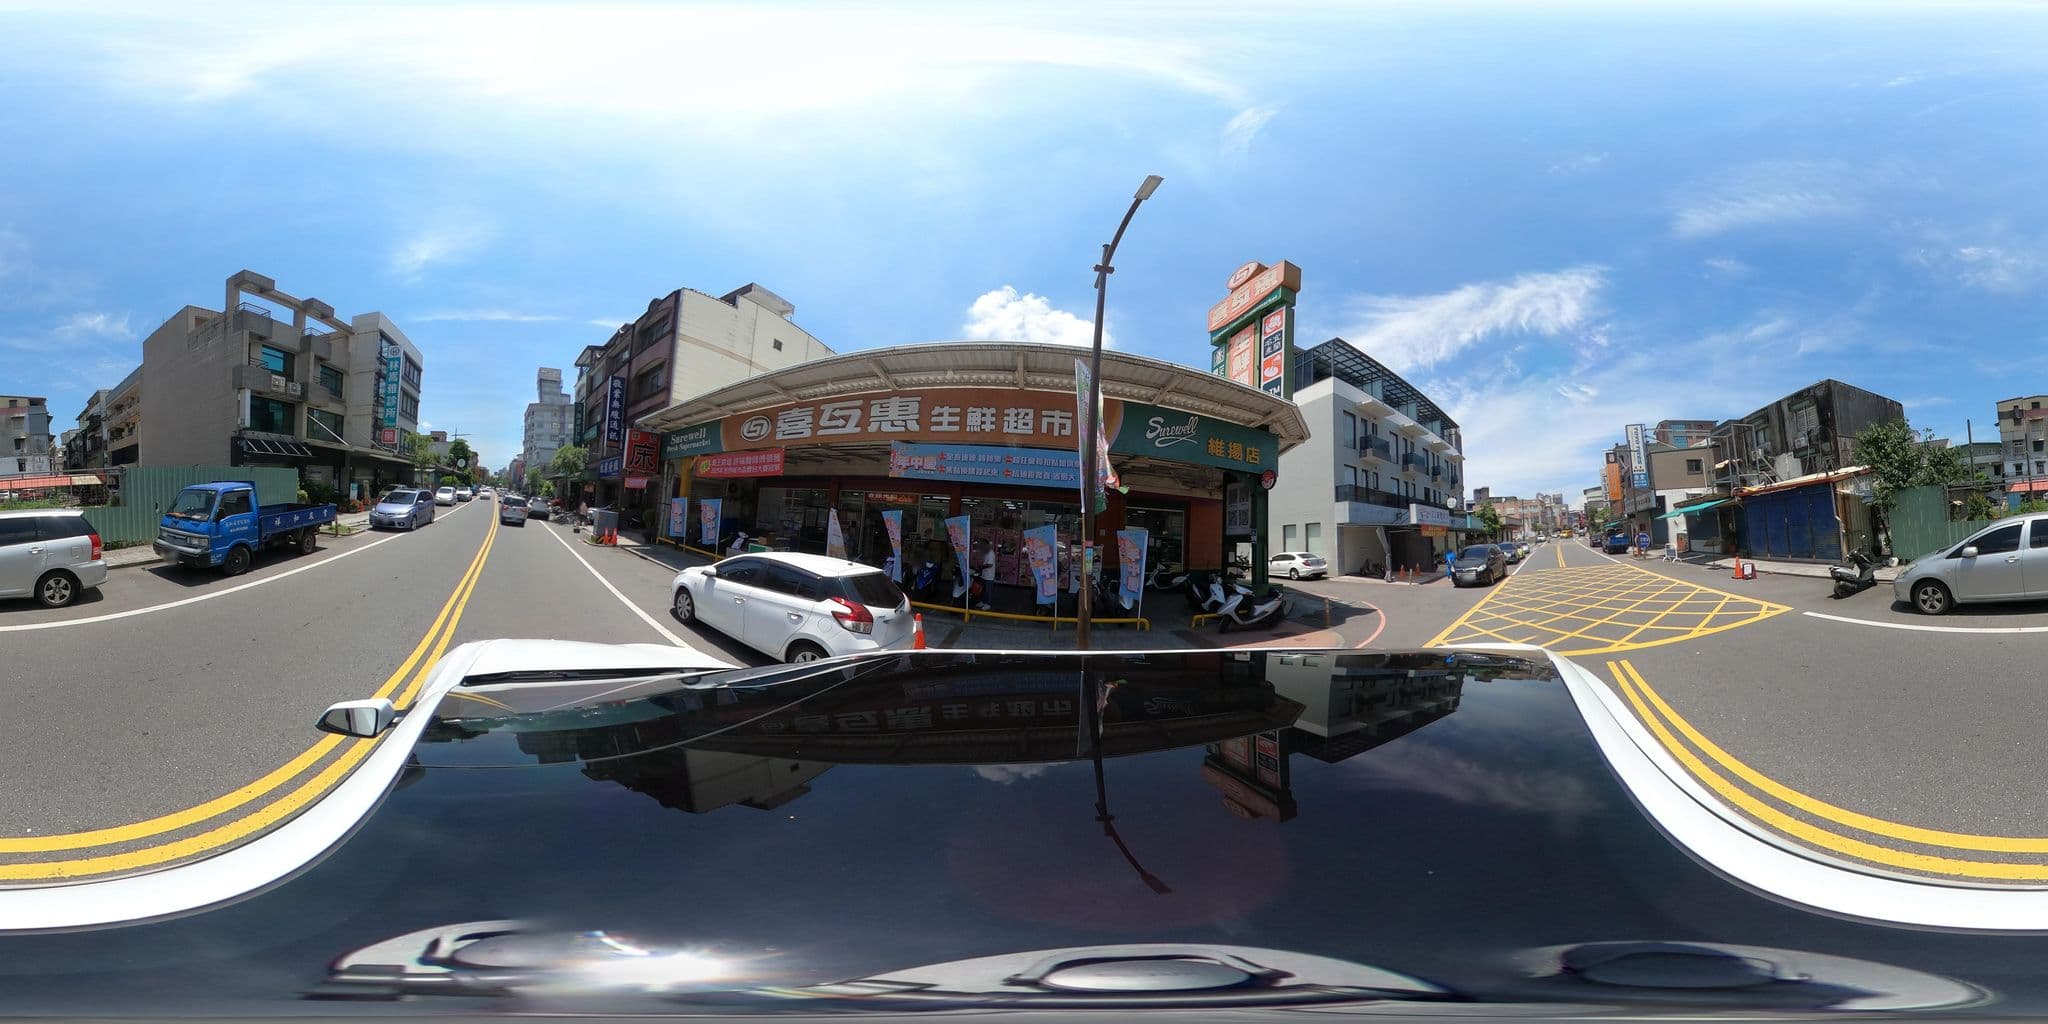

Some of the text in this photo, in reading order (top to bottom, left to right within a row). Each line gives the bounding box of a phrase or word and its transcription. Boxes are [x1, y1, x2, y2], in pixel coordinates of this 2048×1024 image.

[776, 396, 1073, 440] 喜互惠 生鮮超市
[1146, 416, 1200, 447] Surewell
[670, 427, 706, 445] Surewell
[1207, 437, 1261, 464] 維揚店
